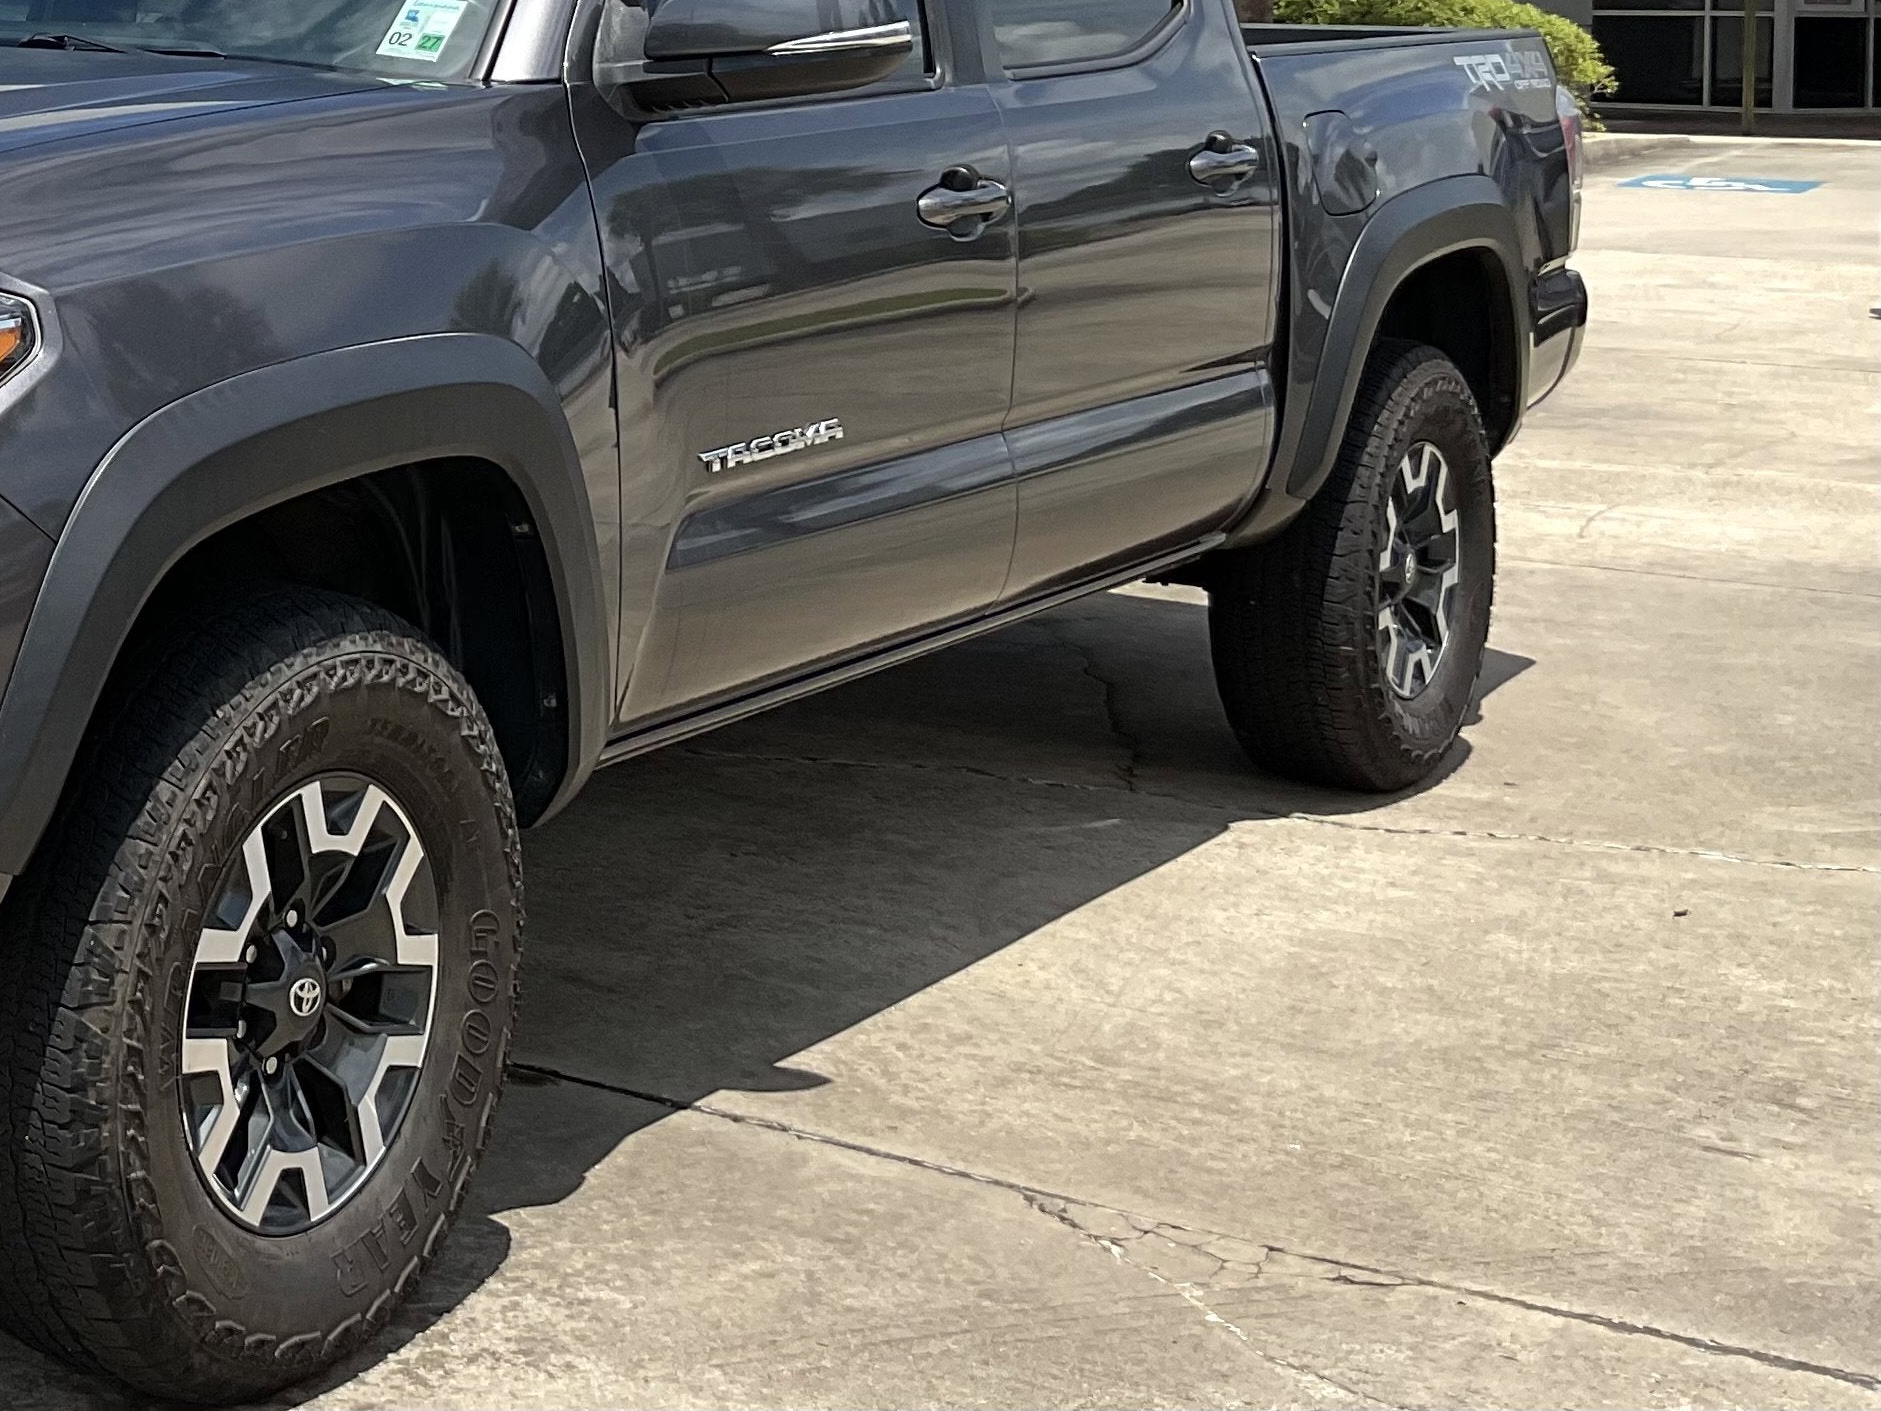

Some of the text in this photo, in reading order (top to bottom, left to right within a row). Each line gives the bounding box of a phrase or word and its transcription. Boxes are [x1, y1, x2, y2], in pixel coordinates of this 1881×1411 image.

[388, 31, 413, 47] 02
[419, 35, 443, 50] 27
[1453, 53, 1510, 91] TRD
[697, 417, 845, 473] TACOMA
[330, 907, 500, 1296] GOODYEAR
